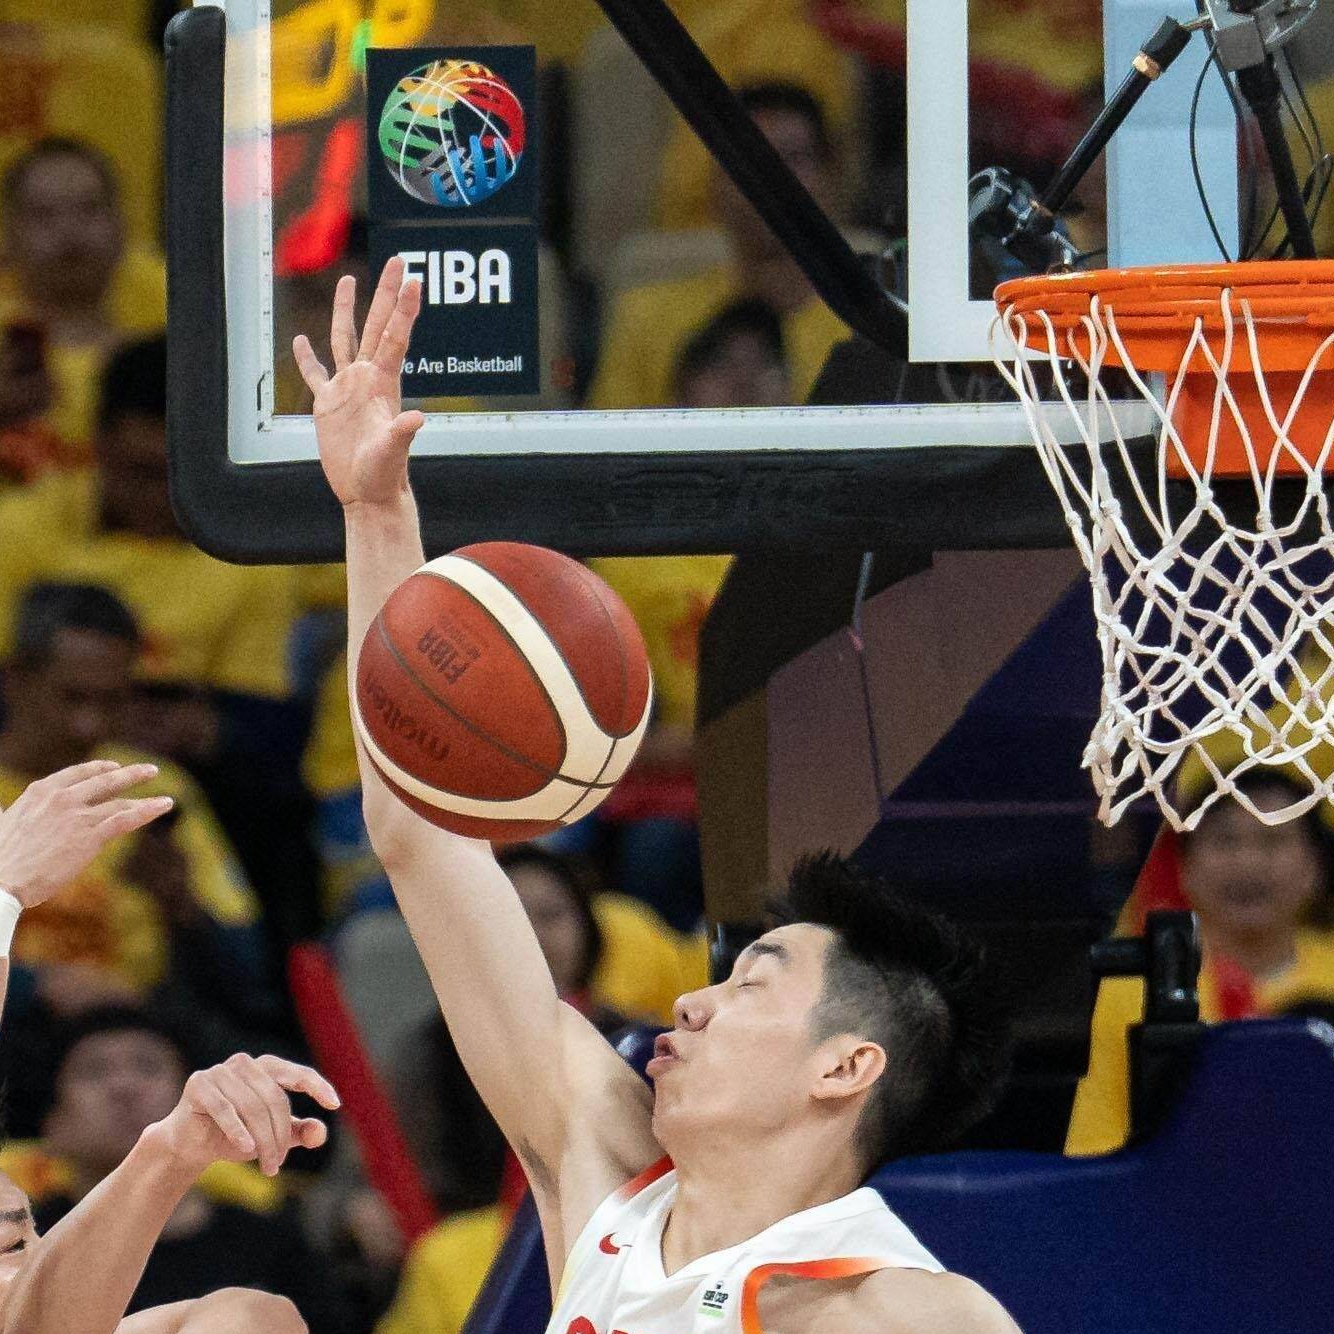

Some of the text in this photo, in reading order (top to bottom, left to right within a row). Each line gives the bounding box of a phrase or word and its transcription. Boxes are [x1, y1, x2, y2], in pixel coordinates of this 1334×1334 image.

[397, 249, 511, 304] FIBA
[417, 357, 444, 374] Are
[447, 356, 523, 374] Basketball
